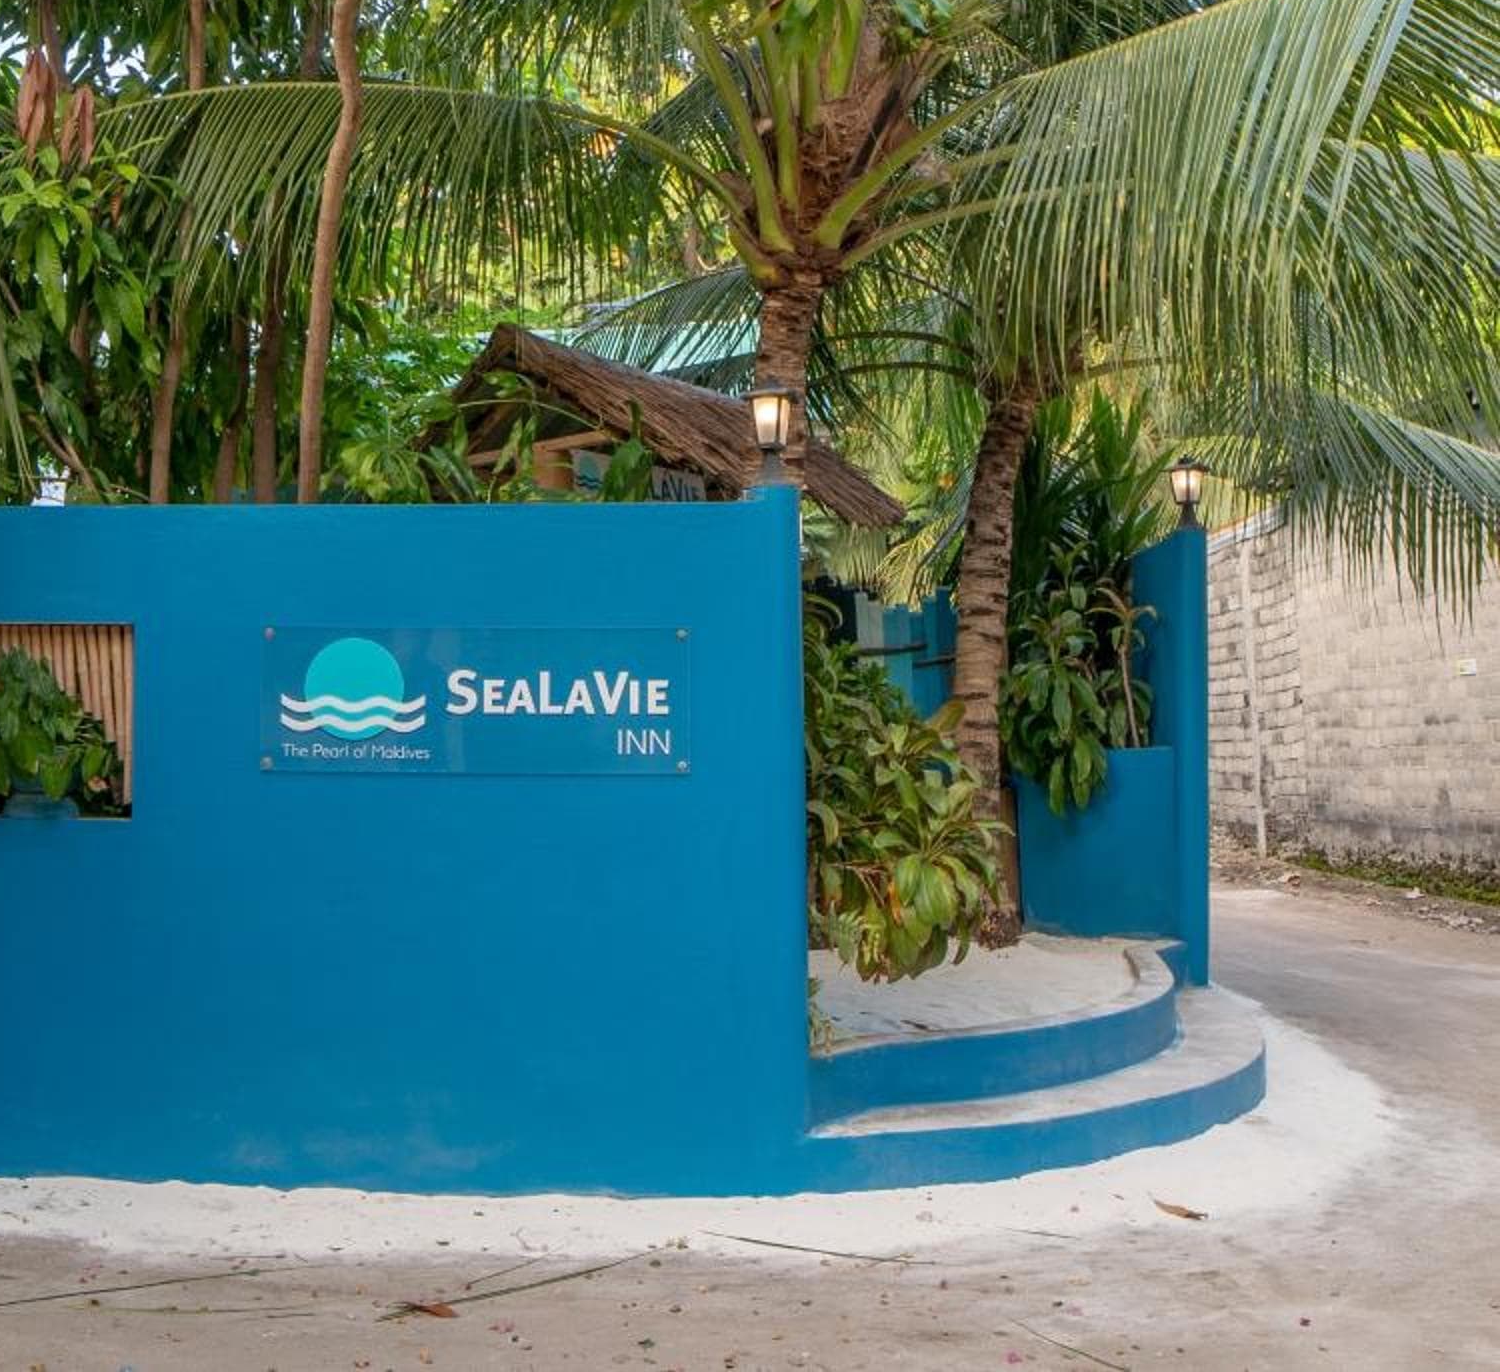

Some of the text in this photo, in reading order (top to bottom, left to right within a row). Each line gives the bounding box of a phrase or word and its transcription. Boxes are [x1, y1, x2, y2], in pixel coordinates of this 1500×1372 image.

[282, 742, 431, 760] The Pearl of Maldives
[616, 729, 672, 755] INN
